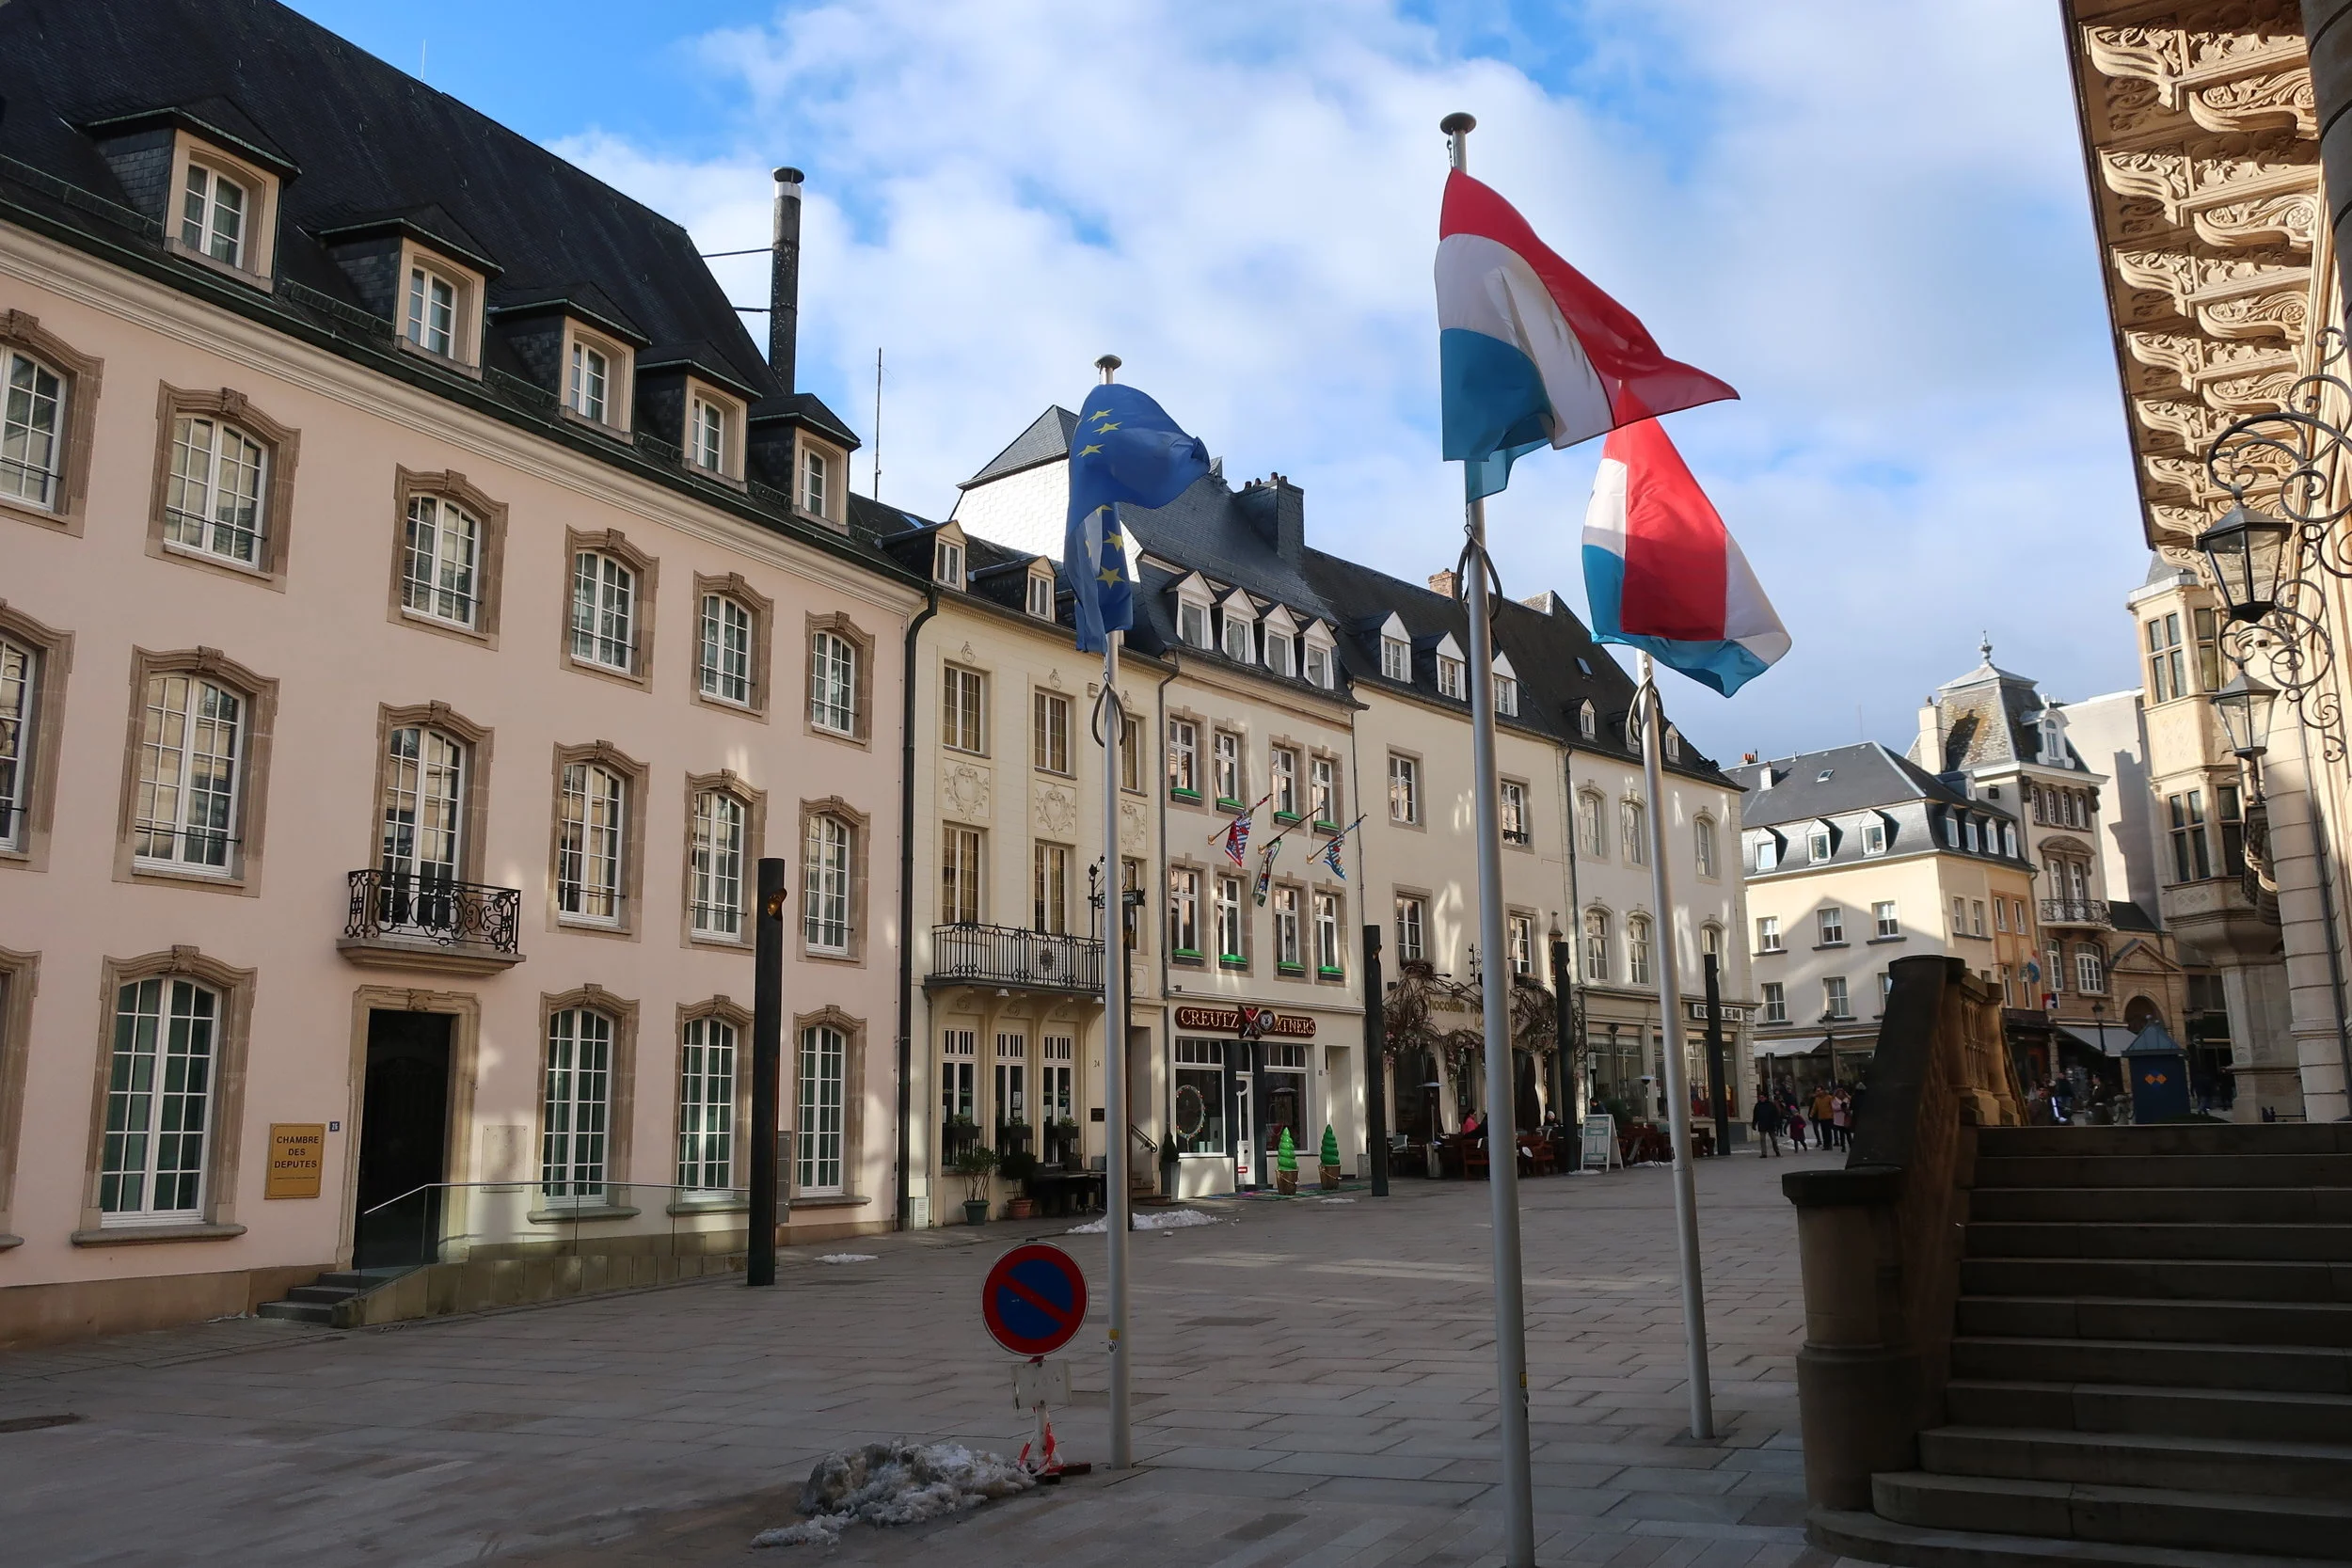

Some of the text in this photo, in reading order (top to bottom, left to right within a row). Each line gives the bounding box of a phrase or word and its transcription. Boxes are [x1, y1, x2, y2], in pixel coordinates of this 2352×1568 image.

[1430, 999, 1465, 1013] hocolate
[1181, 1009, 1239, 1029] CREUTZ
[1093, 1059, 1101, 1068] 24
[276, 1135, 319, 1144] CHAMBRE
[288, 1148, 306, 1156] DES
[274, 1160, 317, 1168] DEPUTES
